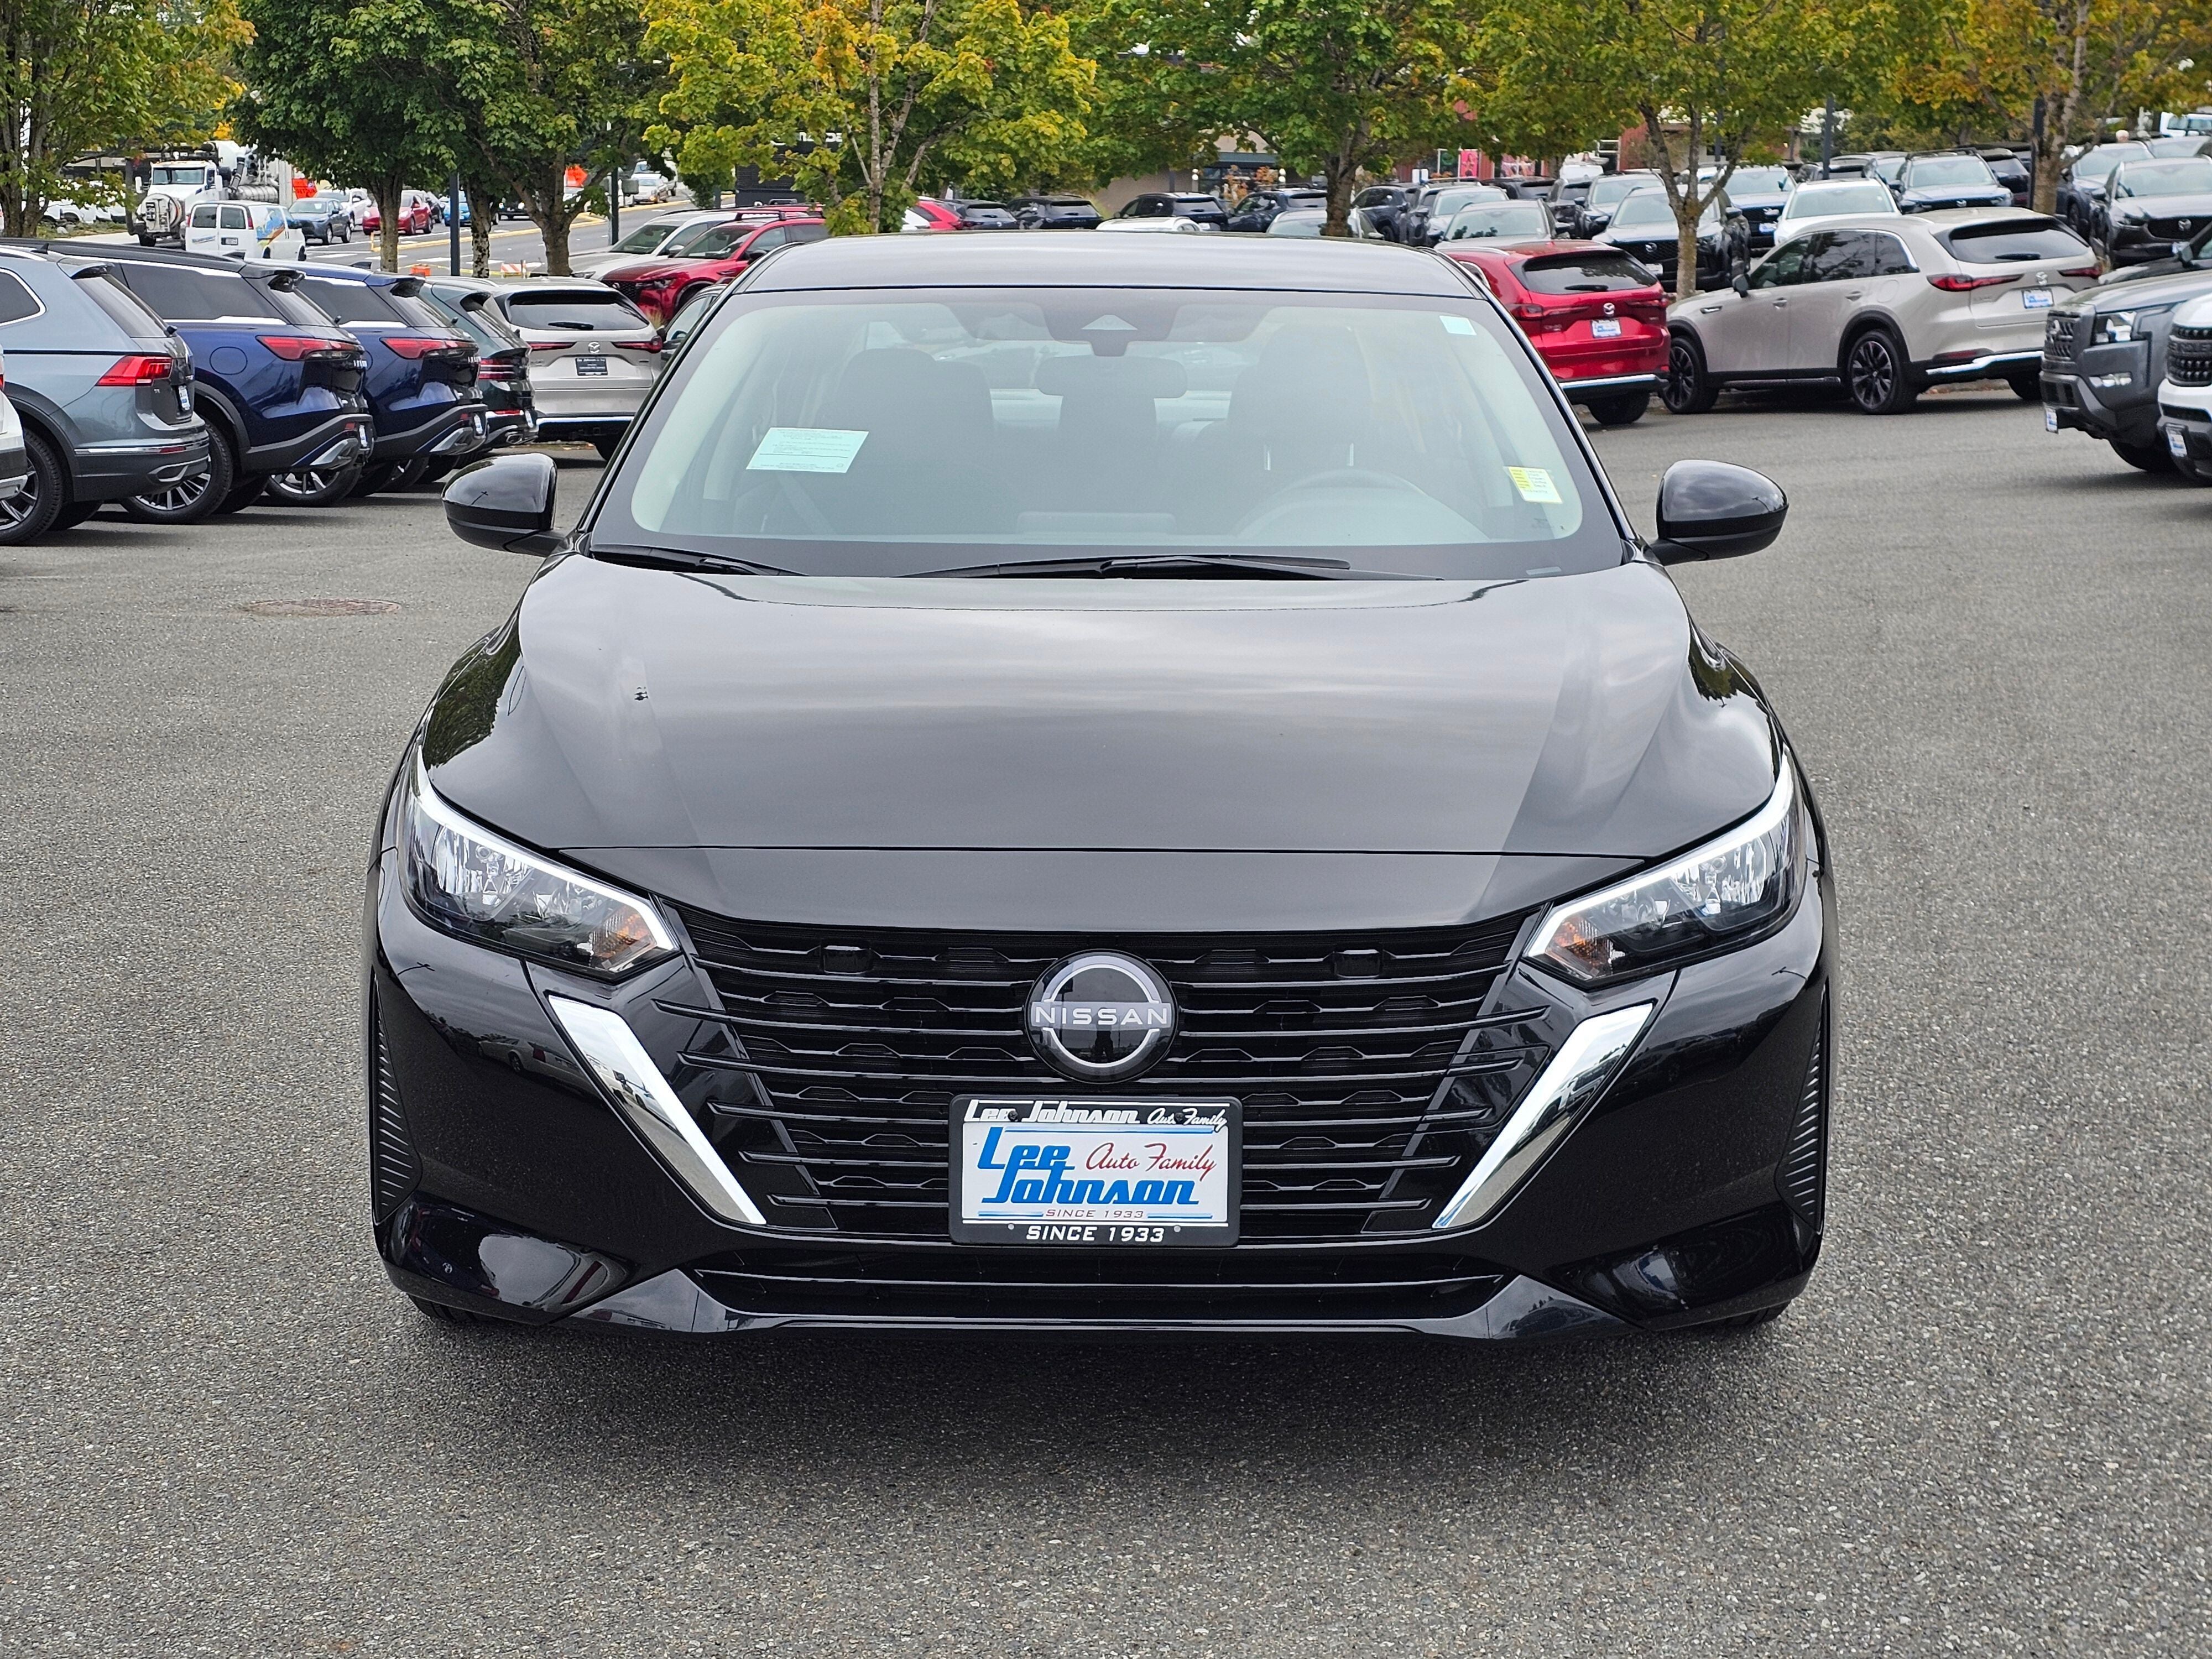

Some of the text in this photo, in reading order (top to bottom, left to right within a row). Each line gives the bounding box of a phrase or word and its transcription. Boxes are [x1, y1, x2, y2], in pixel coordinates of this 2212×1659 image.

[1036, 1006, 1167, 1025] NISSAN
[964, 1099, 1227, 1133] Lee Johnson Aut Family
[977, 1126, 1075, 1170] Lee
[1086, 1142, 1217, 1182] Auto Family
[981, 1167, 1199, 1205] Johnson
[1046, 1209, 1144, 1219] SINCE 1933
[1026, 1225, 1165, 1243] SINCE 1933
